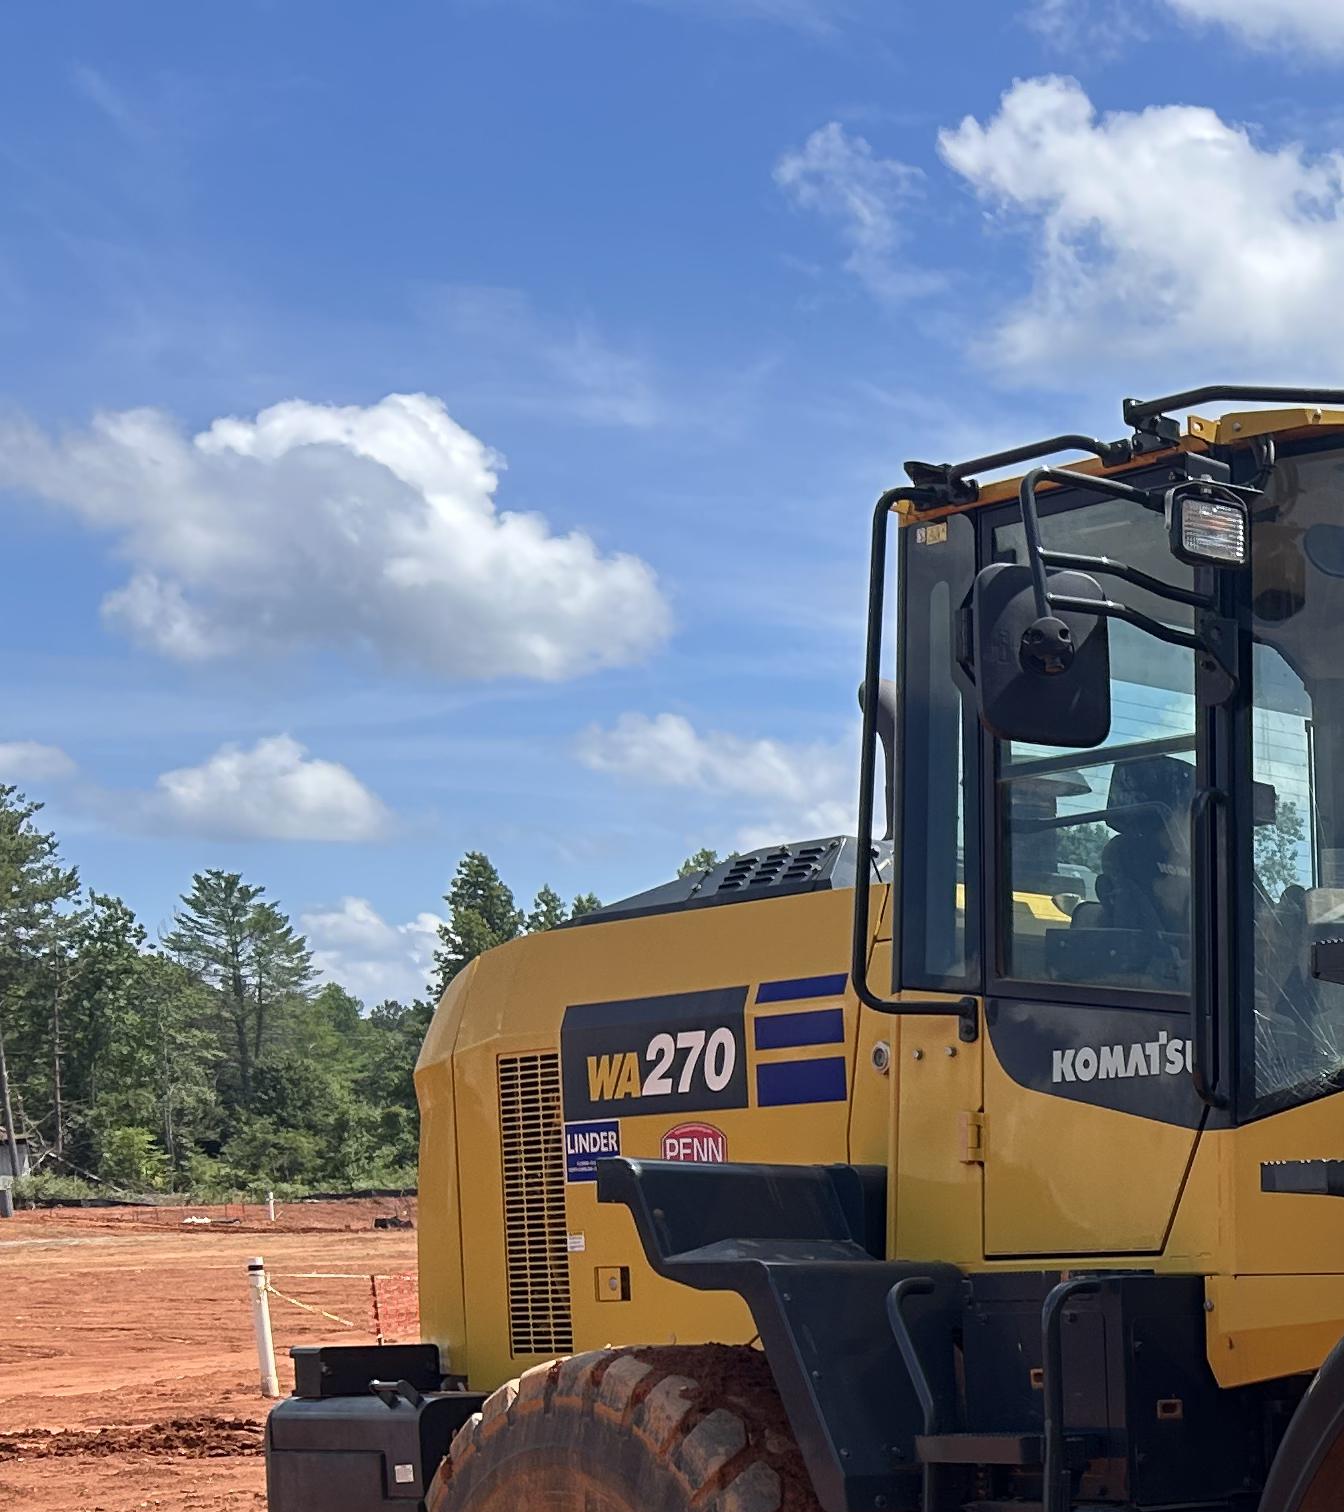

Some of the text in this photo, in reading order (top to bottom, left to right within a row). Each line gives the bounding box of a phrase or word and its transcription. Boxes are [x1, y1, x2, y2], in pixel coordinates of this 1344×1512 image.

[587, 1027, 736, 1101] WA270
[566, 1131, 618, 1155] LINDER
[665, 1137, 723, 1162] PENN
